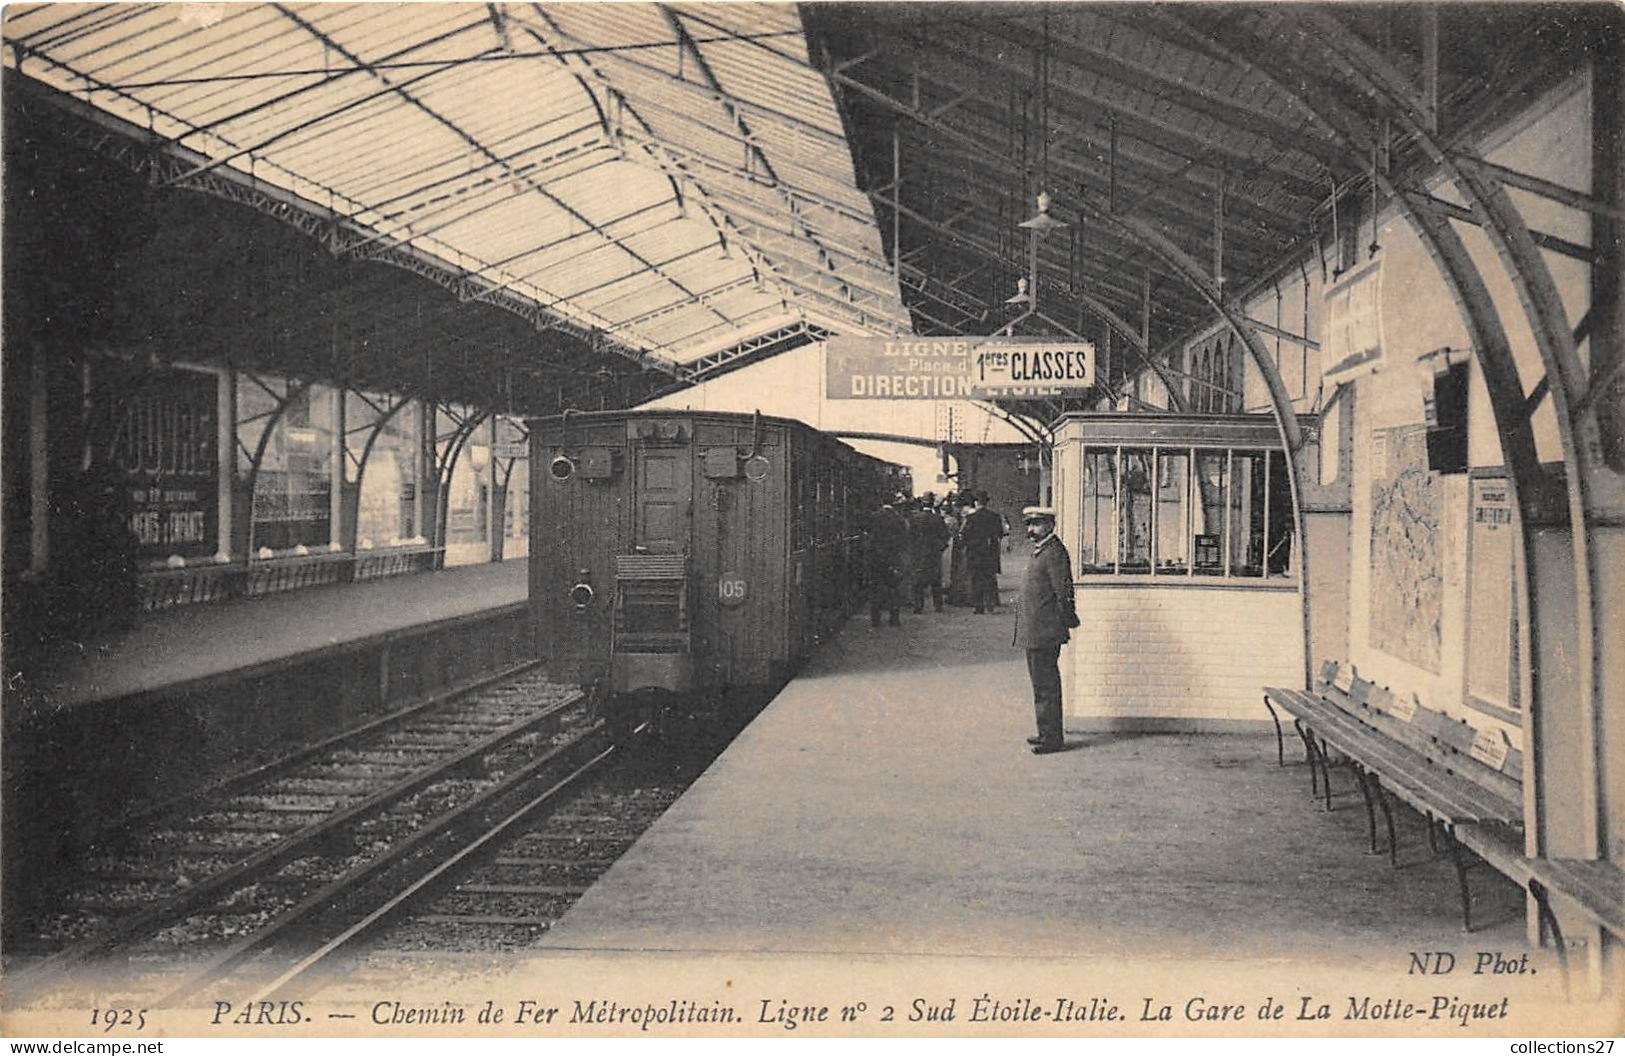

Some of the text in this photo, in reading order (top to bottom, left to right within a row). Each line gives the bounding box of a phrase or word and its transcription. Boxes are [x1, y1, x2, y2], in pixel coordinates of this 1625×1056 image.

[884, 341, 967, 356] LIGNE
[1011, 351, 1086, 381] CLASSES
[851, 374, 972, 396] DIRECTION
[718, 579, 746, 598] 105
